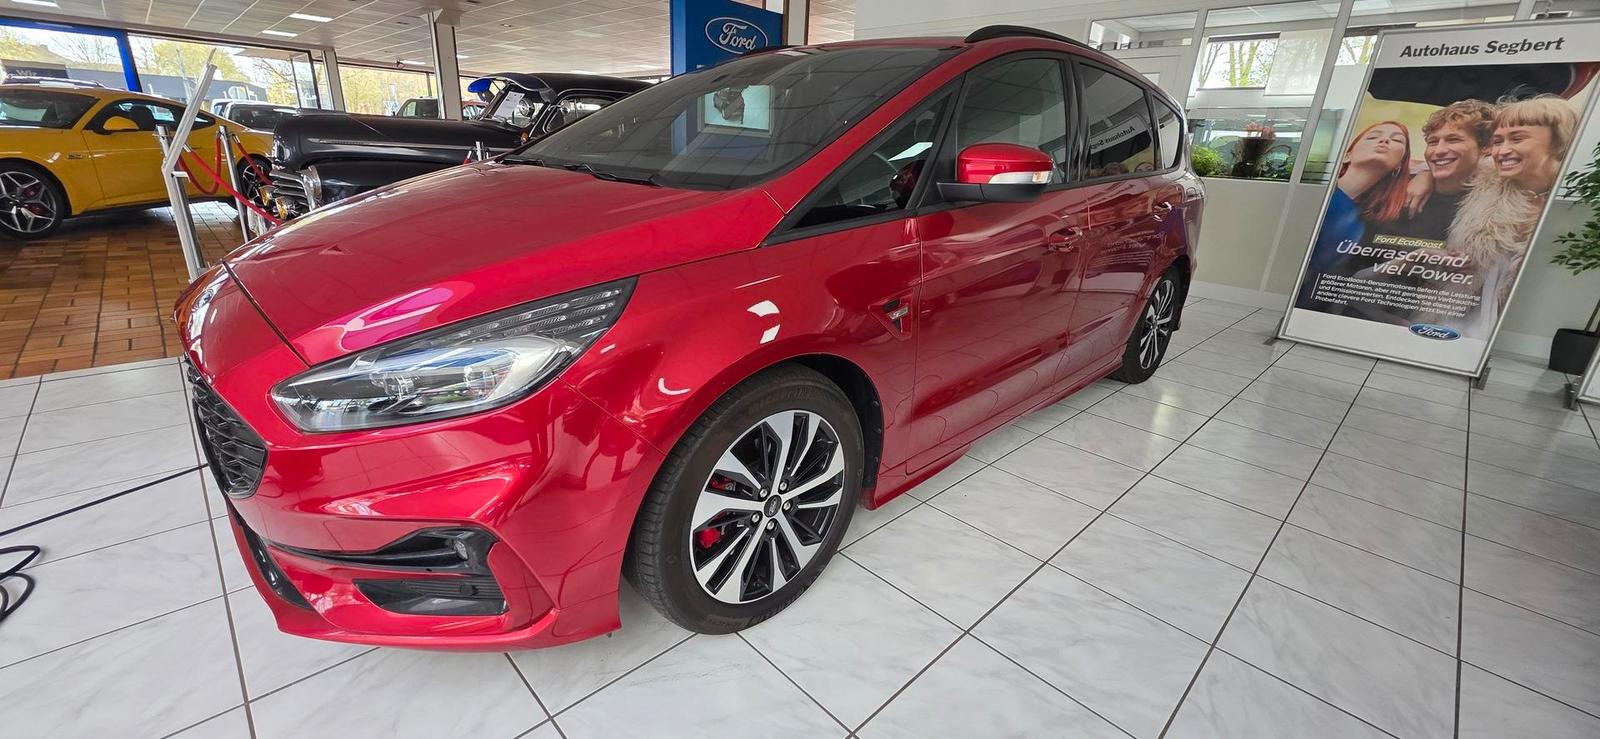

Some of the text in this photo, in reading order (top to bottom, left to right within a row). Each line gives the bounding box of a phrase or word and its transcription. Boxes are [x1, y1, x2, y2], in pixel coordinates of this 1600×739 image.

[719, 22, 757, 50] Ford
[1400, 37, 1565, 57] Autohaus Segbert
[1374, 235, 1444, 249] Ford EcoBoost
[1336, 239, 1469, 268] Überraschend
[1373, 262, 1474, 285] viel Power.
[1315, 295, 1348, 305] Probefahrt.
[1331, 285, 1384, 299] Emissionswerten.
[1385, 294, 1420, 304] Entdecken
[1432, 301, 1451, 309] diese
[1451, 304, 1467, 312] und
[1346, 283, 1373, 291] Motoren,
[1401, 291, 1437, 301] geringeren
[1437, 296, 1480, 306] Verbrauchs-
[1416, 286, 1438, 295] liefern
[1450, 291, 1480, 301] Leistung
[1376, 298, 1419, 310] Technologien
[1418, 305, 1435, 313] jetzt
[1447, 310, 1465, 318] einer
[1417, 326, 1450, 339] Ford
